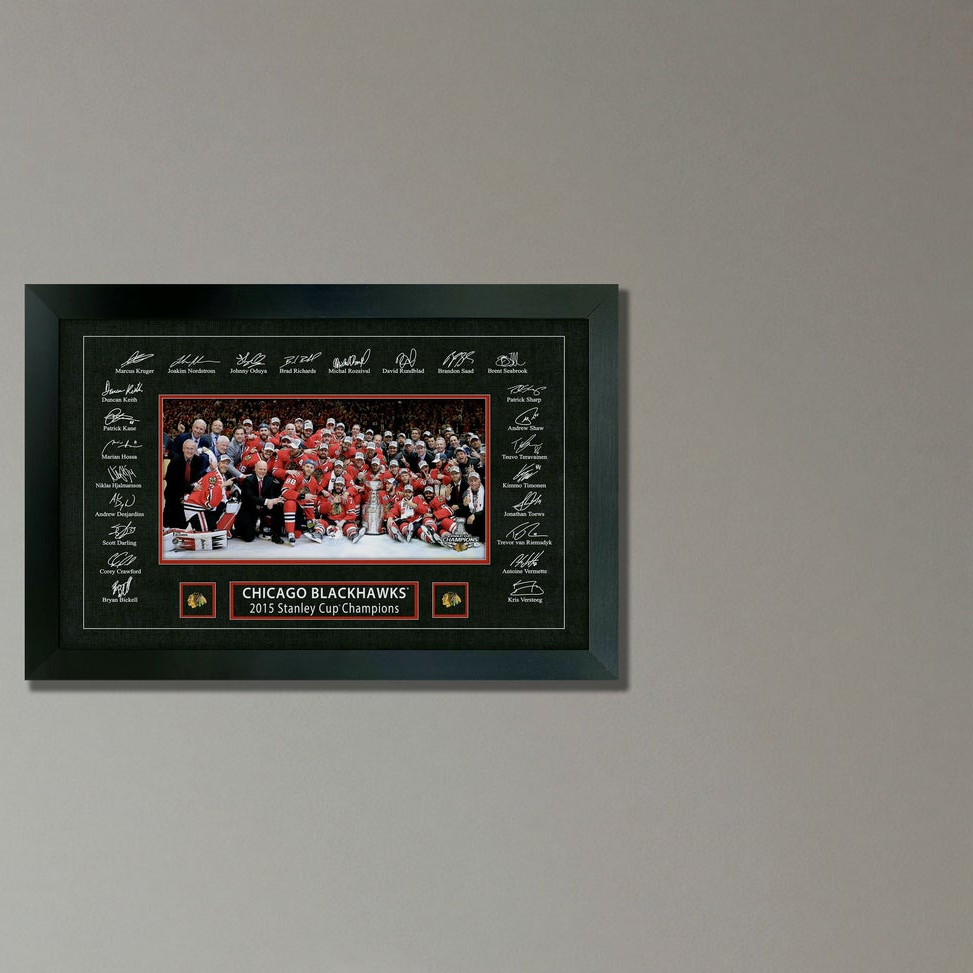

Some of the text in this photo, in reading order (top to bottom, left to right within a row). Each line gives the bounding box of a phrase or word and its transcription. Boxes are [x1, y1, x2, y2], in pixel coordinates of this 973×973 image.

[242, 586, 407, 599] CHICAGO BLACKHAWKS
[249, 603, 400, 616] 2015 Stanley Cup Champions
